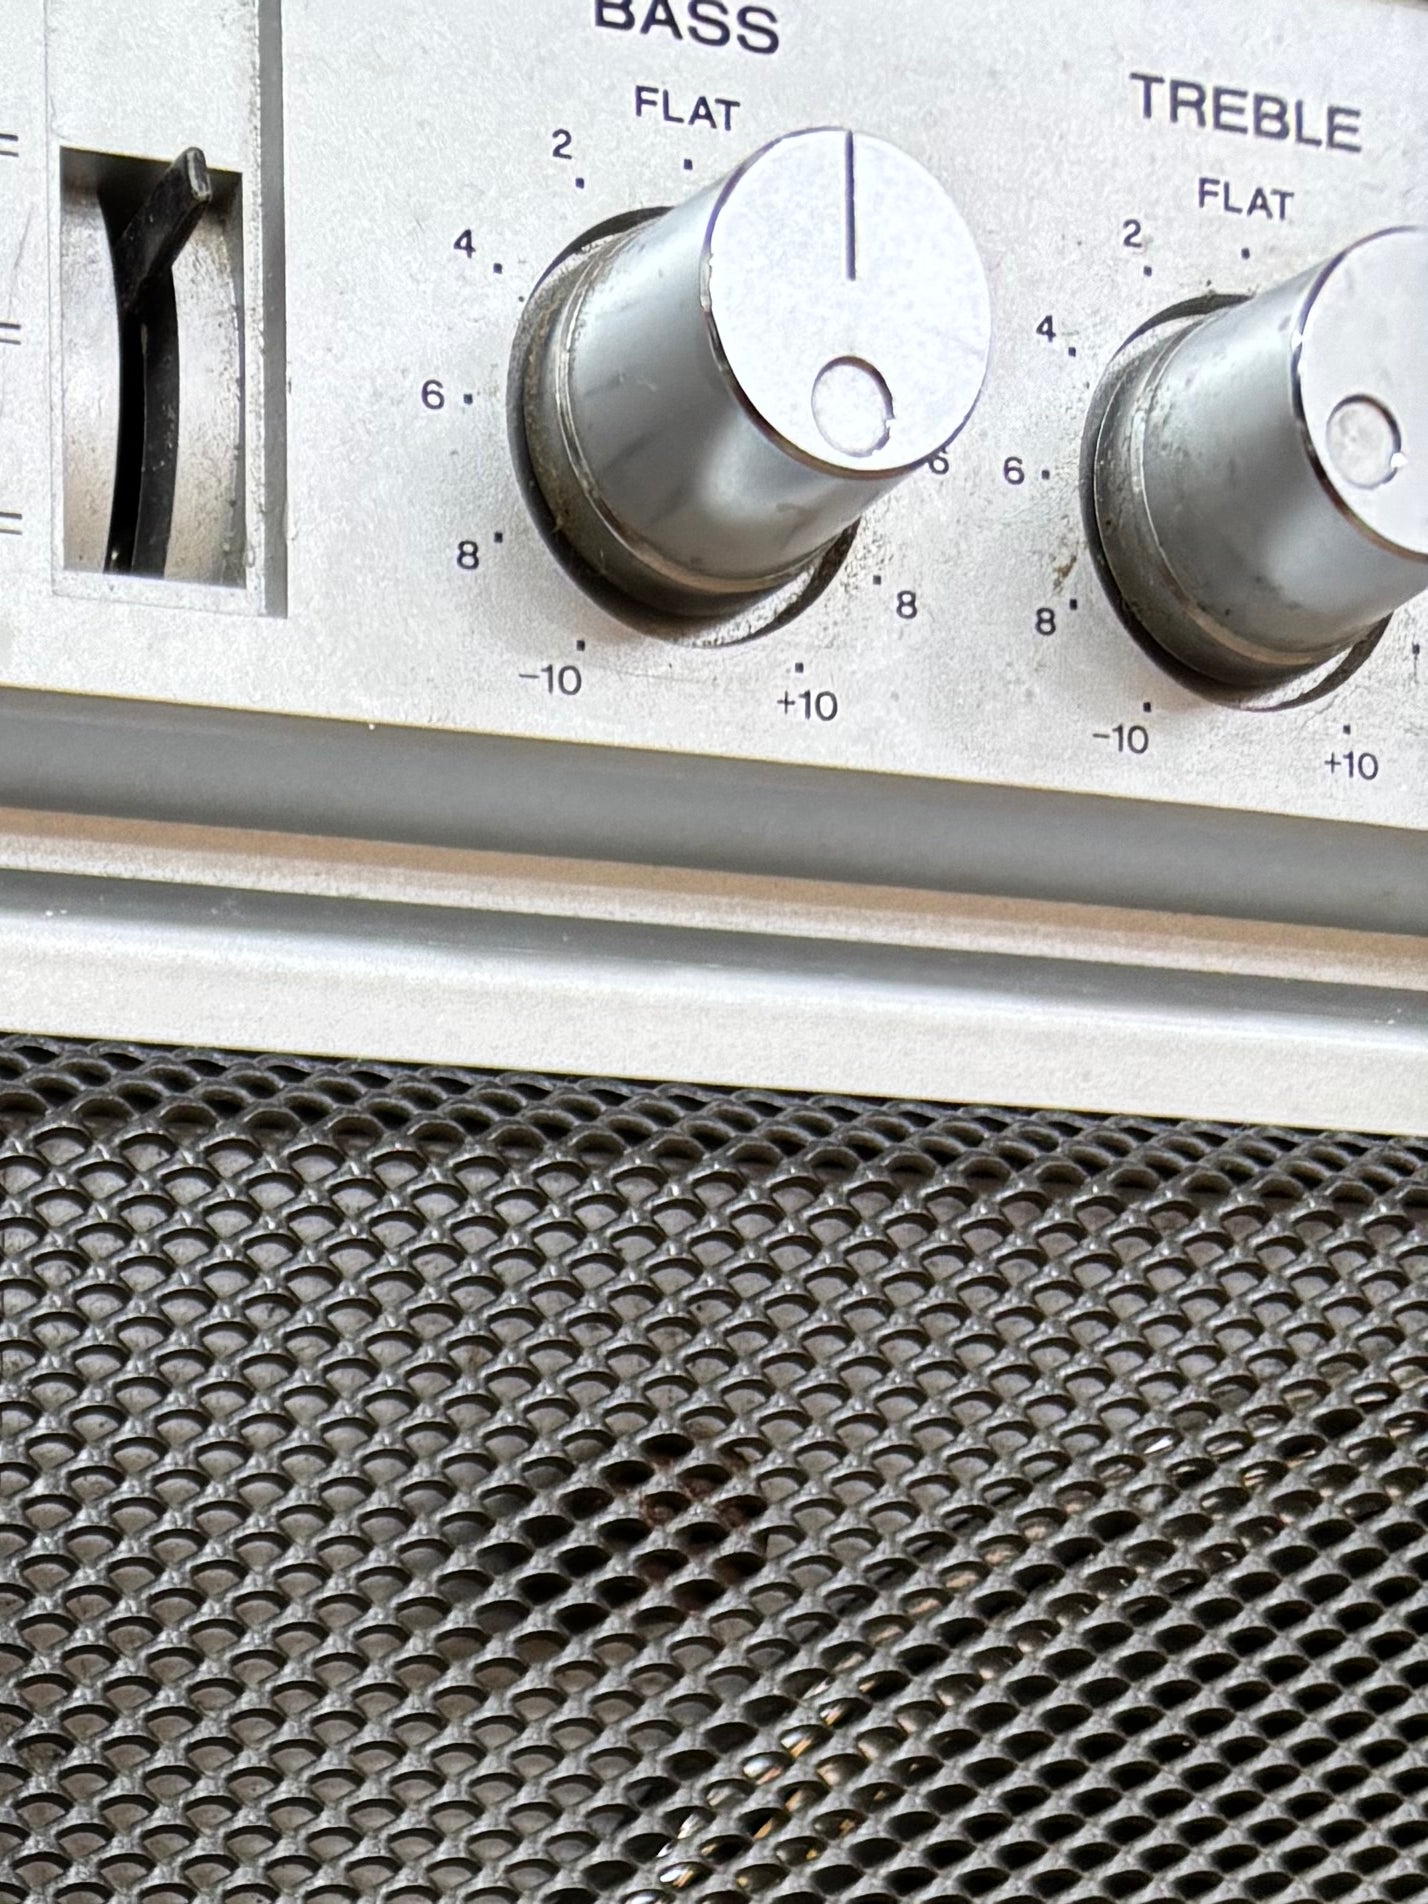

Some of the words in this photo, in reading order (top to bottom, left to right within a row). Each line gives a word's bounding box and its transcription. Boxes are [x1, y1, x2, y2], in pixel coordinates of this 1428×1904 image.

[595, 0, 779, 54] BASS
[636, 85, 740, 131] FLAT
[1129, 72, 1361, 153] TREBLE
[552, 129, 572, 159] 2
[1199, 177, 1294, 221] FLAT
[454, 229, 476, 258] 4
[1123, 219, 1142, 248] 2
[1036, 315, 1056, 342] 4
[422, 380, 444, 409] 6
[1004, 457, 1025, 485] 6
[457, 540, 479, 570] 8
[896, 591, 917, 619] 8
[1035, 607, 1056, 636] 8
[777, 690, 837, 721] +10
[1325, 751, 1378, 780] +10
